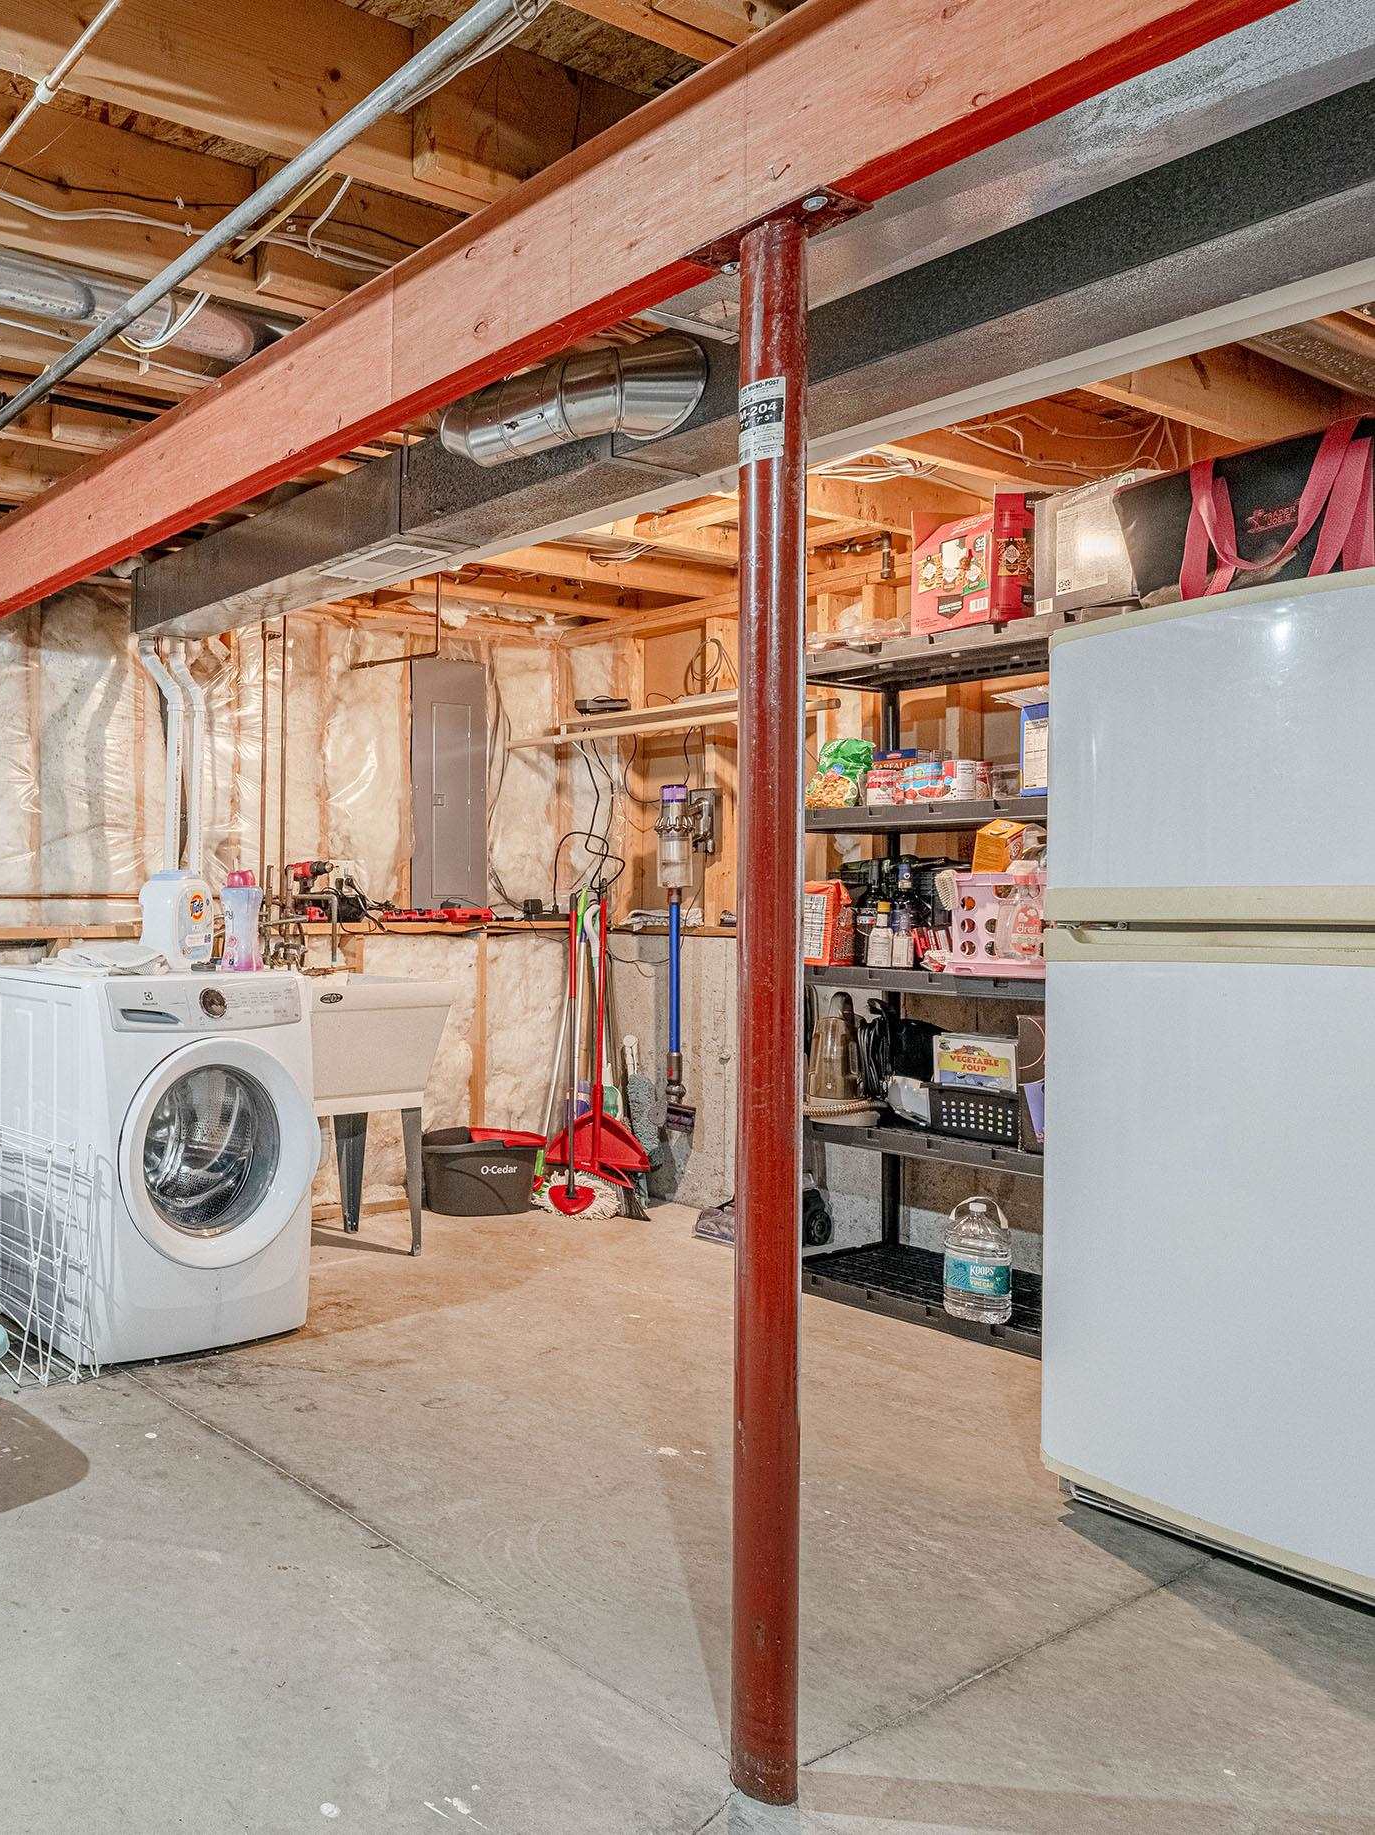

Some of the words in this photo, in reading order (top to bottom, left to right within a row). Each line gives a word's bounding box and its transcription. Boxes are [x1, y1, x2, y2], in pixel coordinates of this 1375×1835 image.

[949, 1054, 1000, 1067] VEGETABLE
[961, 1062, 987, 1073] SOUP
[480, 1164, 518, 1175] O-Cedar
